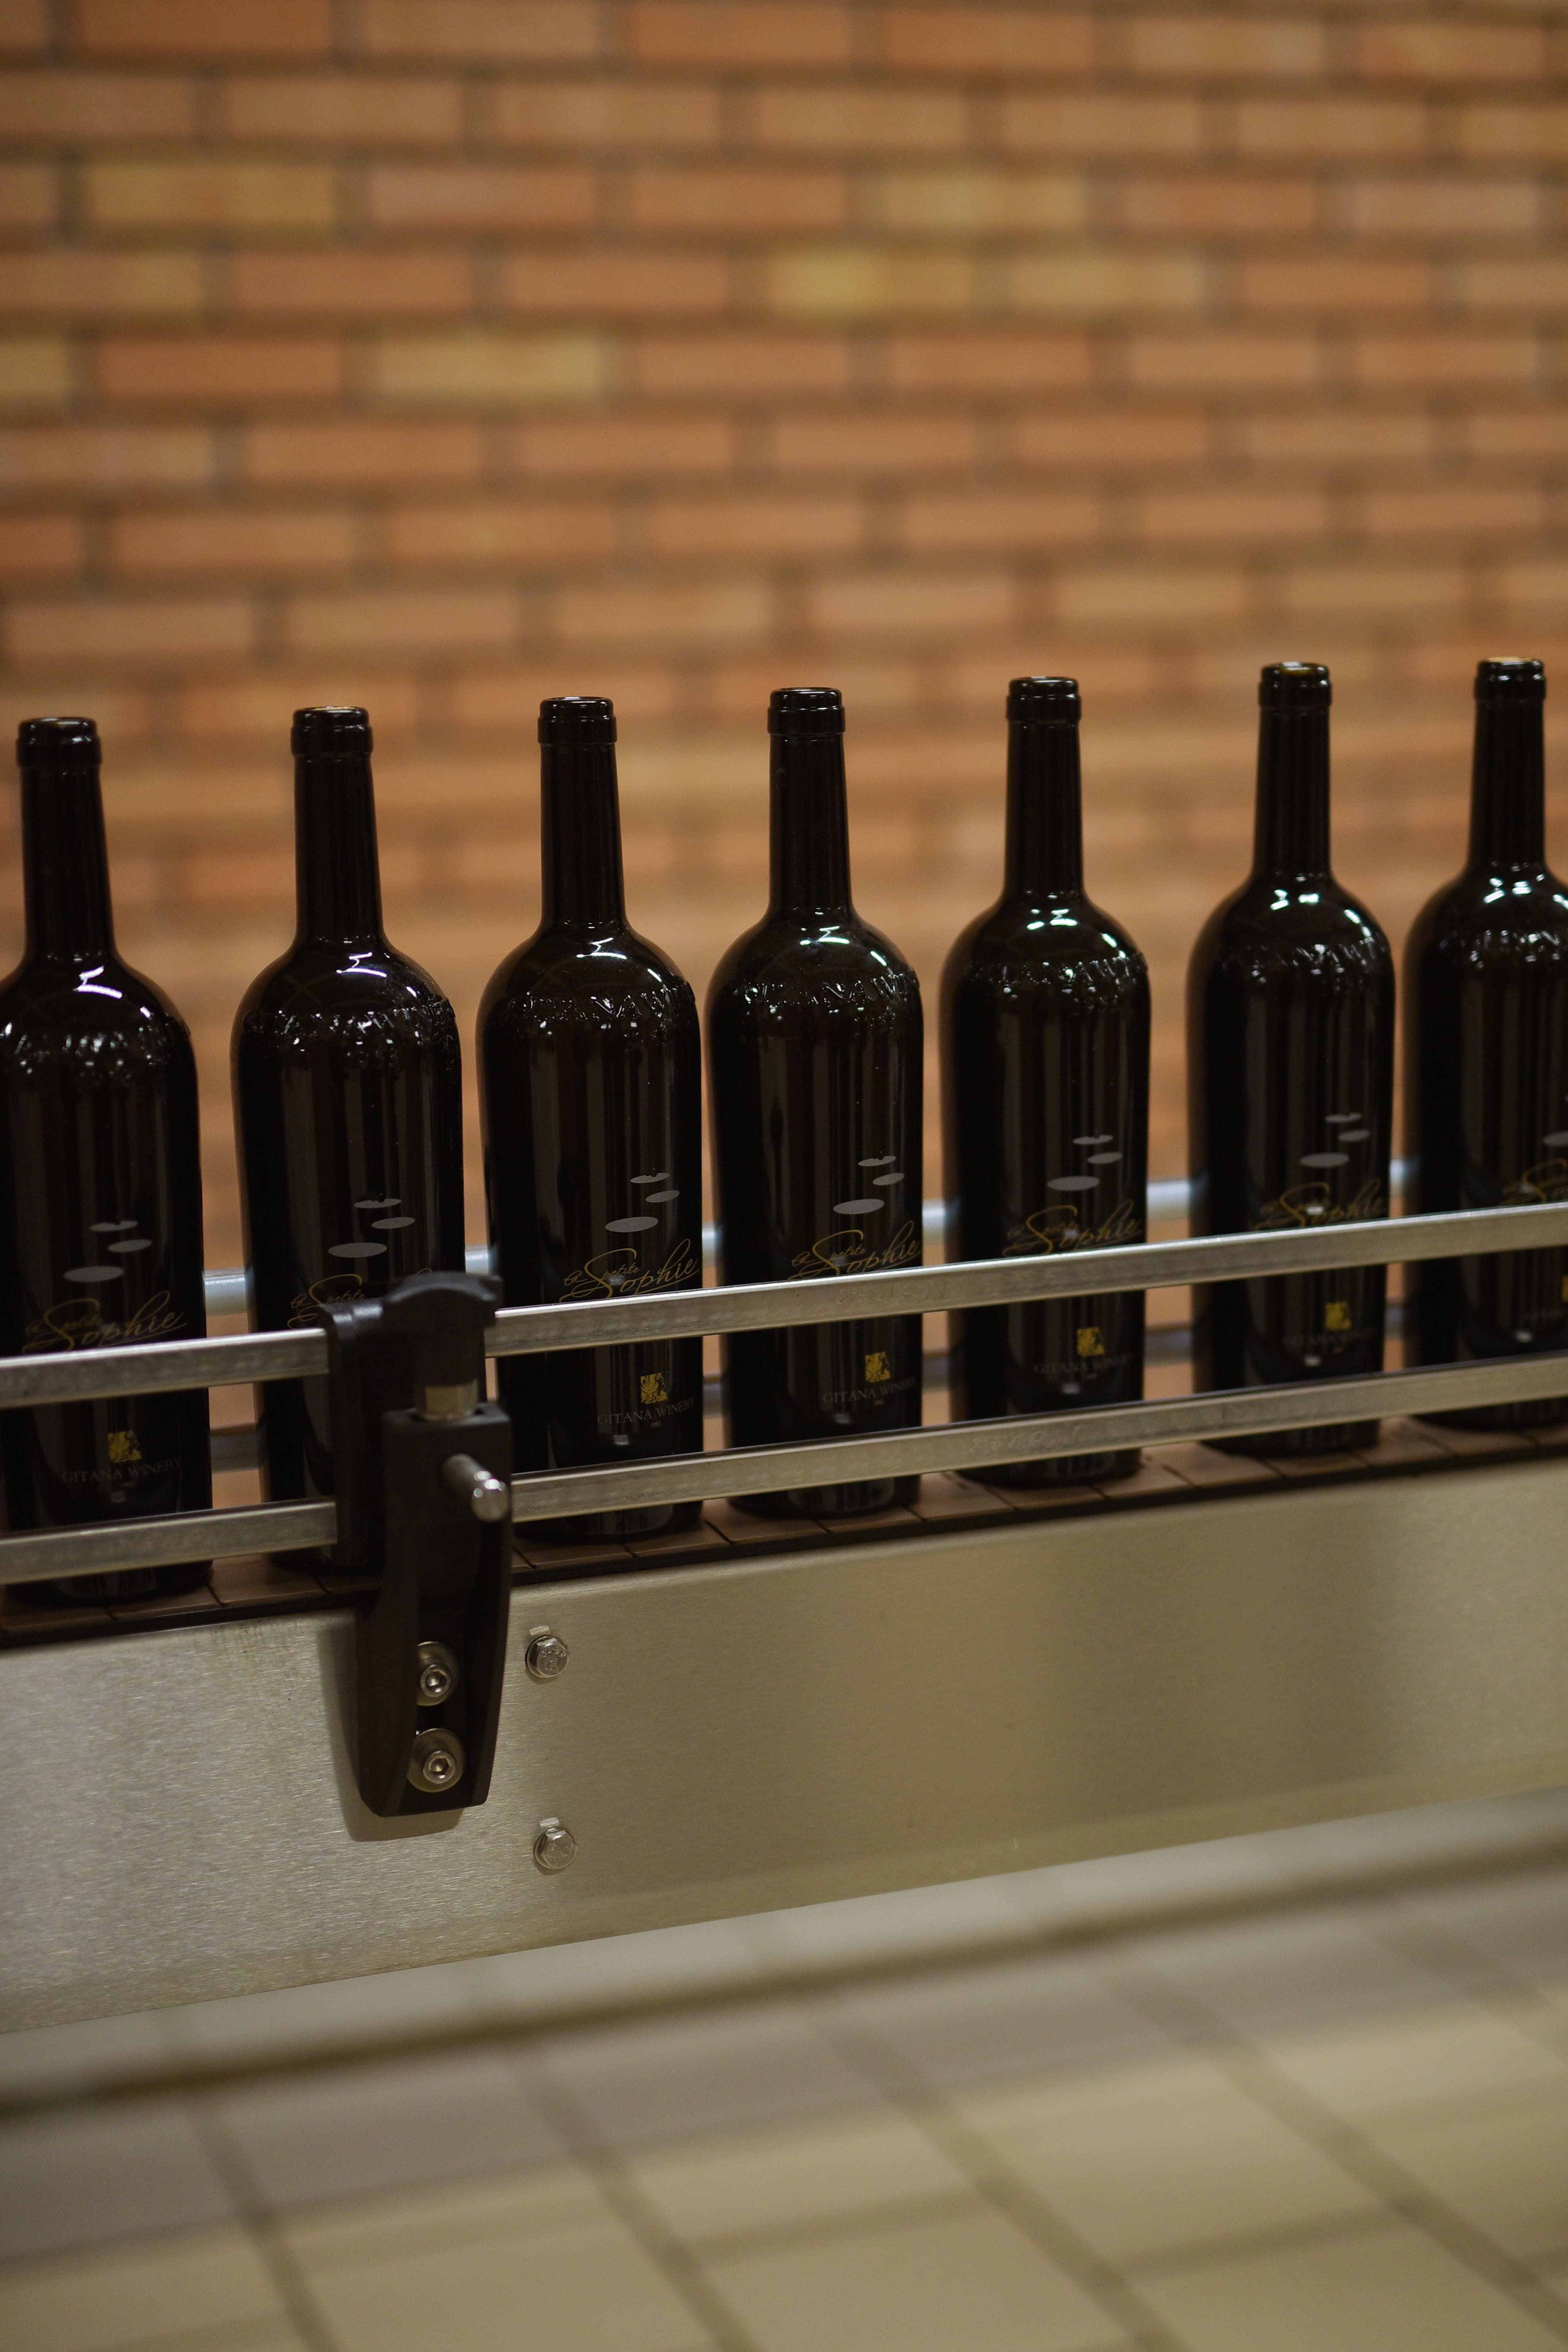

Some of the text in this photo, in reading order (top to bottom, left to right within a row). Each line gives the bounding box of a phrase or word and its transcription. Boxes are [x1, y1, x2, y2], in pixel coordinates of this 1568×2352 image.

[559, 1238, 700, 1302] Sophie
[787, 1220, 920, 1279] Sophie
[22, 1291, 187, 1352] Sophie
[597, 1396, 695, 1425] GITANA WINERY
[823, 1389, 876, 1403] GITANA
[62, 1458, 182, 1482] GITANA WINERY
